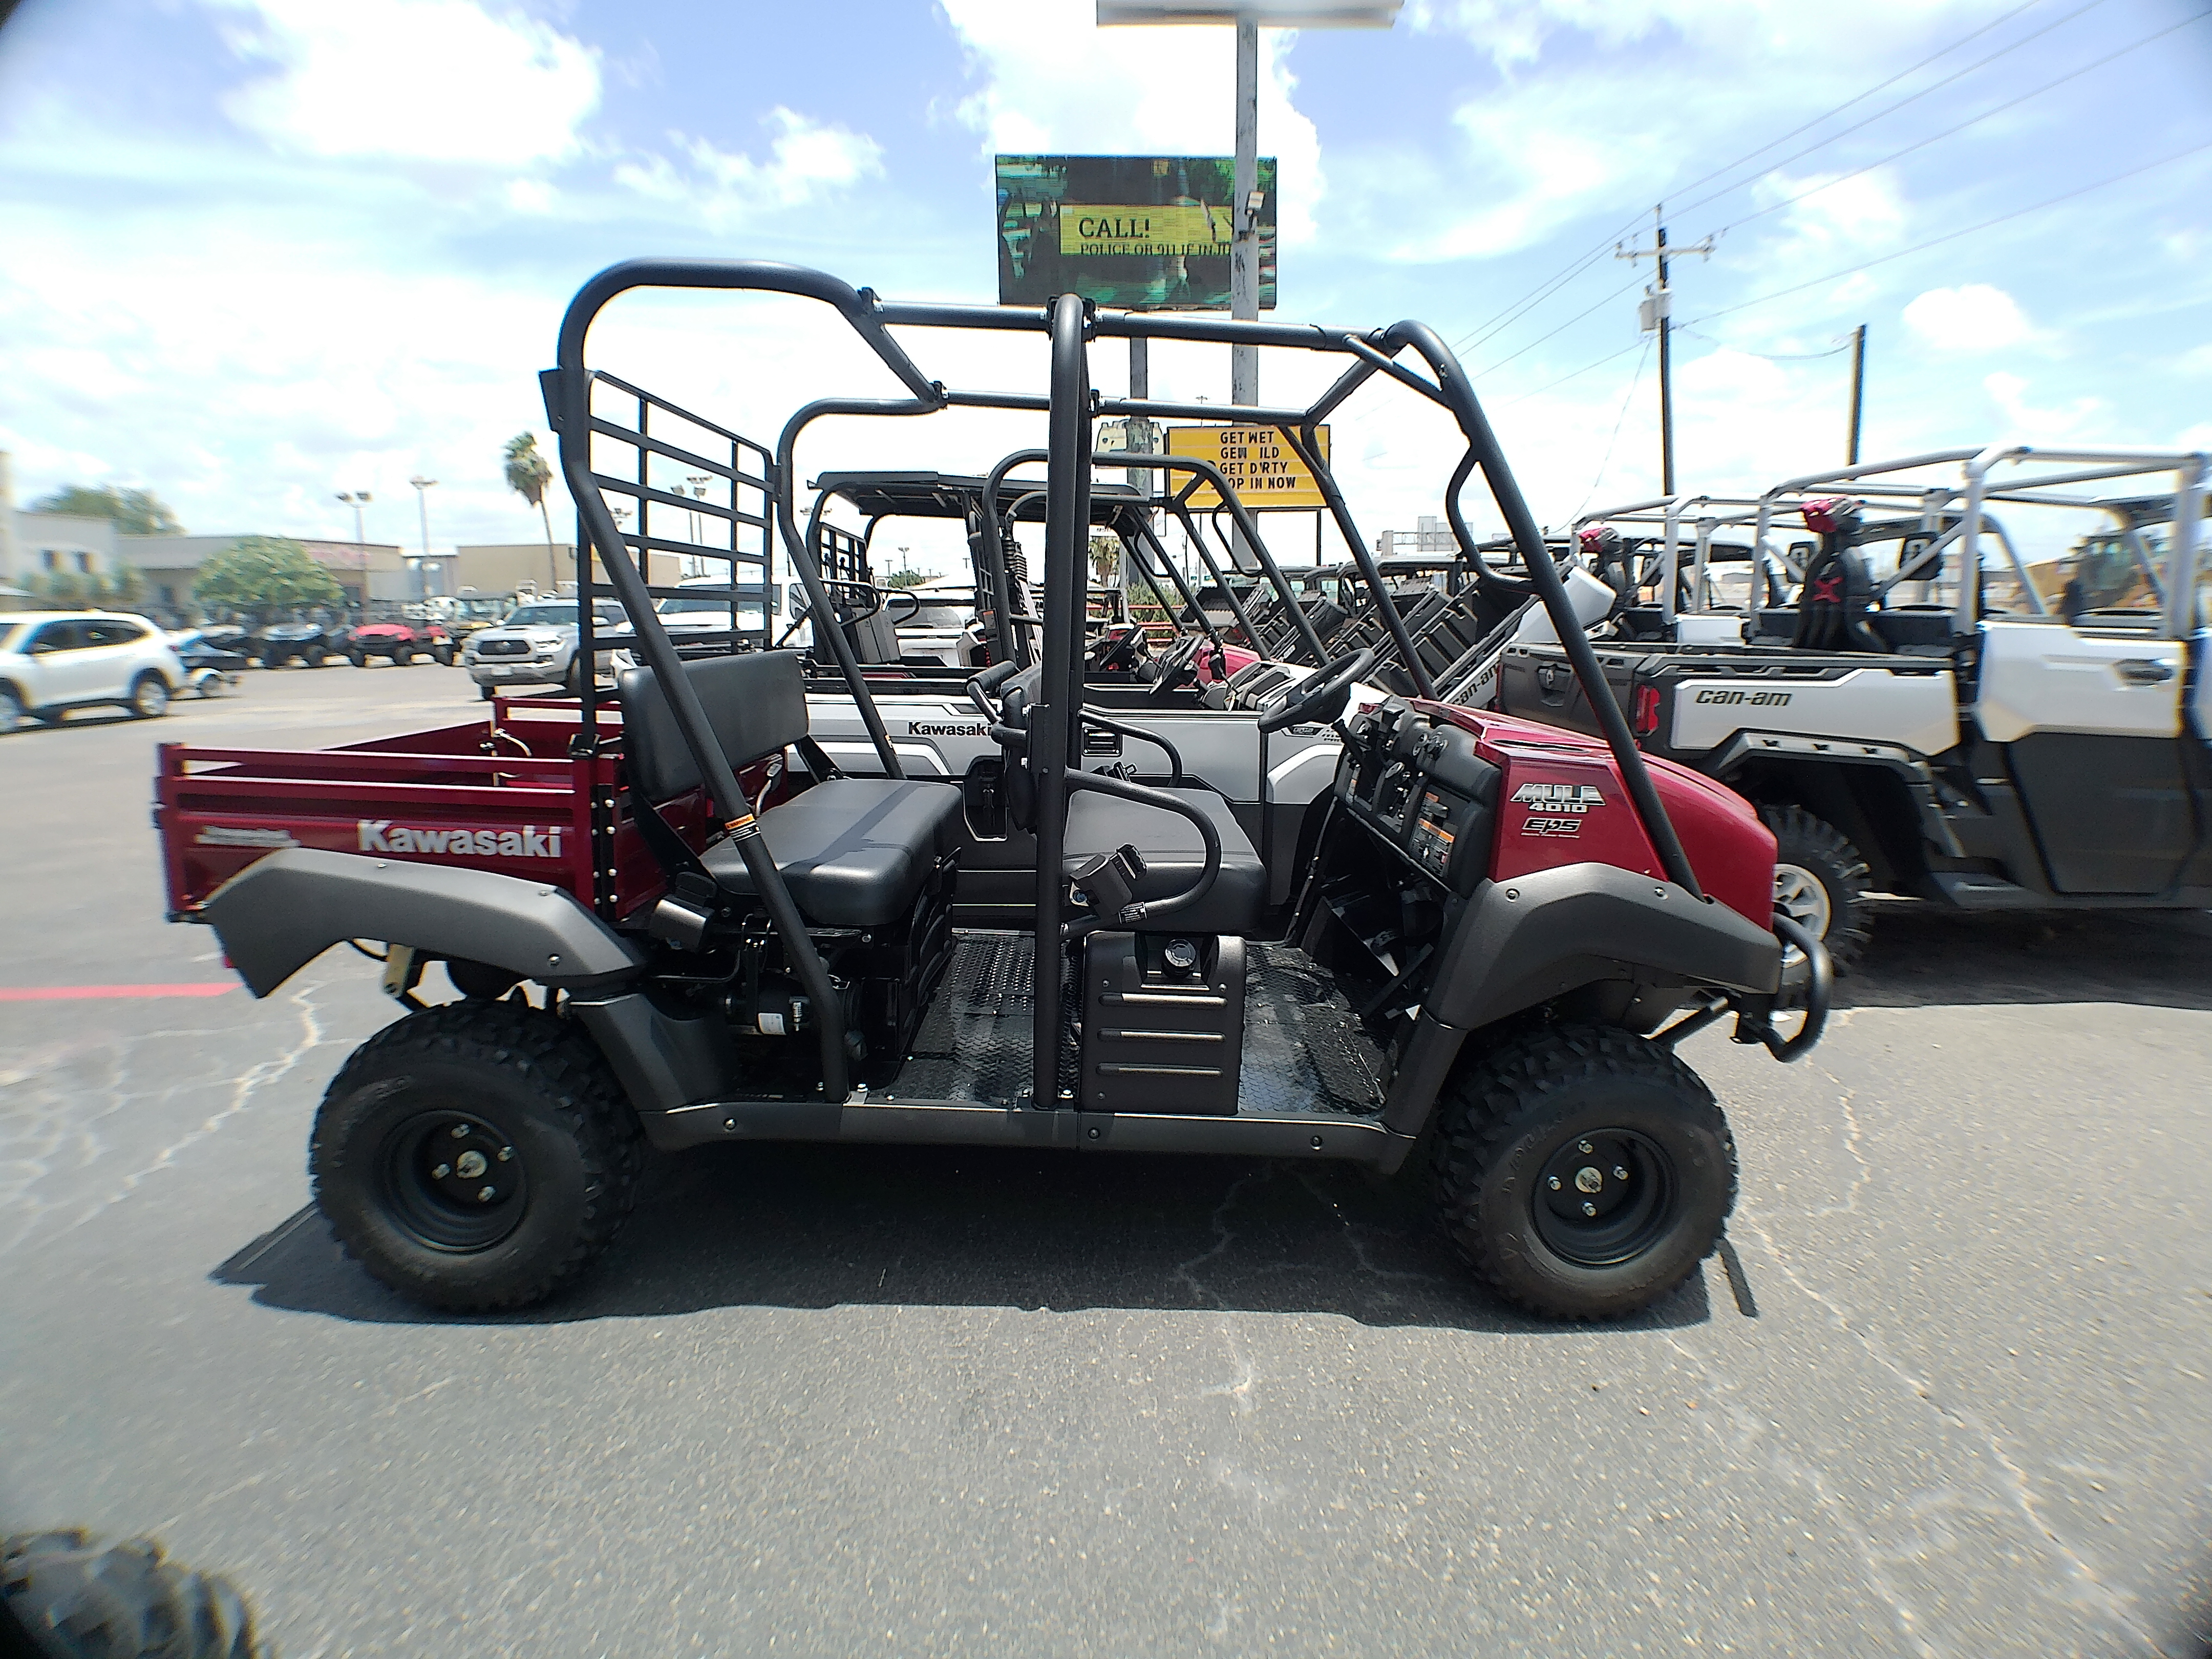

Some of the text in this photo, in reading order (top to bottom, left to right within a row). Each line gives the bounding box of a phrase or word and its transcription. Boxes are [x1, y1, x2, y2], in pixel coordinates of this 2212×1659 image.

[1079, 218, 1150, 238] CALL!
[1080, 243, 1130, 256] POLICE
[1134, 243, 1153, 256] OR
[1220, 431, 1274, 444] GET WET
[1220, 462, 1244, 474] GET
[1250, 477, 1262, 489] IN
[1268, 477, 1296, 489] NOW
[1695, 690, 1792, 706] can-am
[908, 721, 992, 736] Kawasaki
[1510, 783, 1606, 805] MULE
[1528, 802, 1587, 813] 4010
[358, 819, 562, 858] Kawasaki
